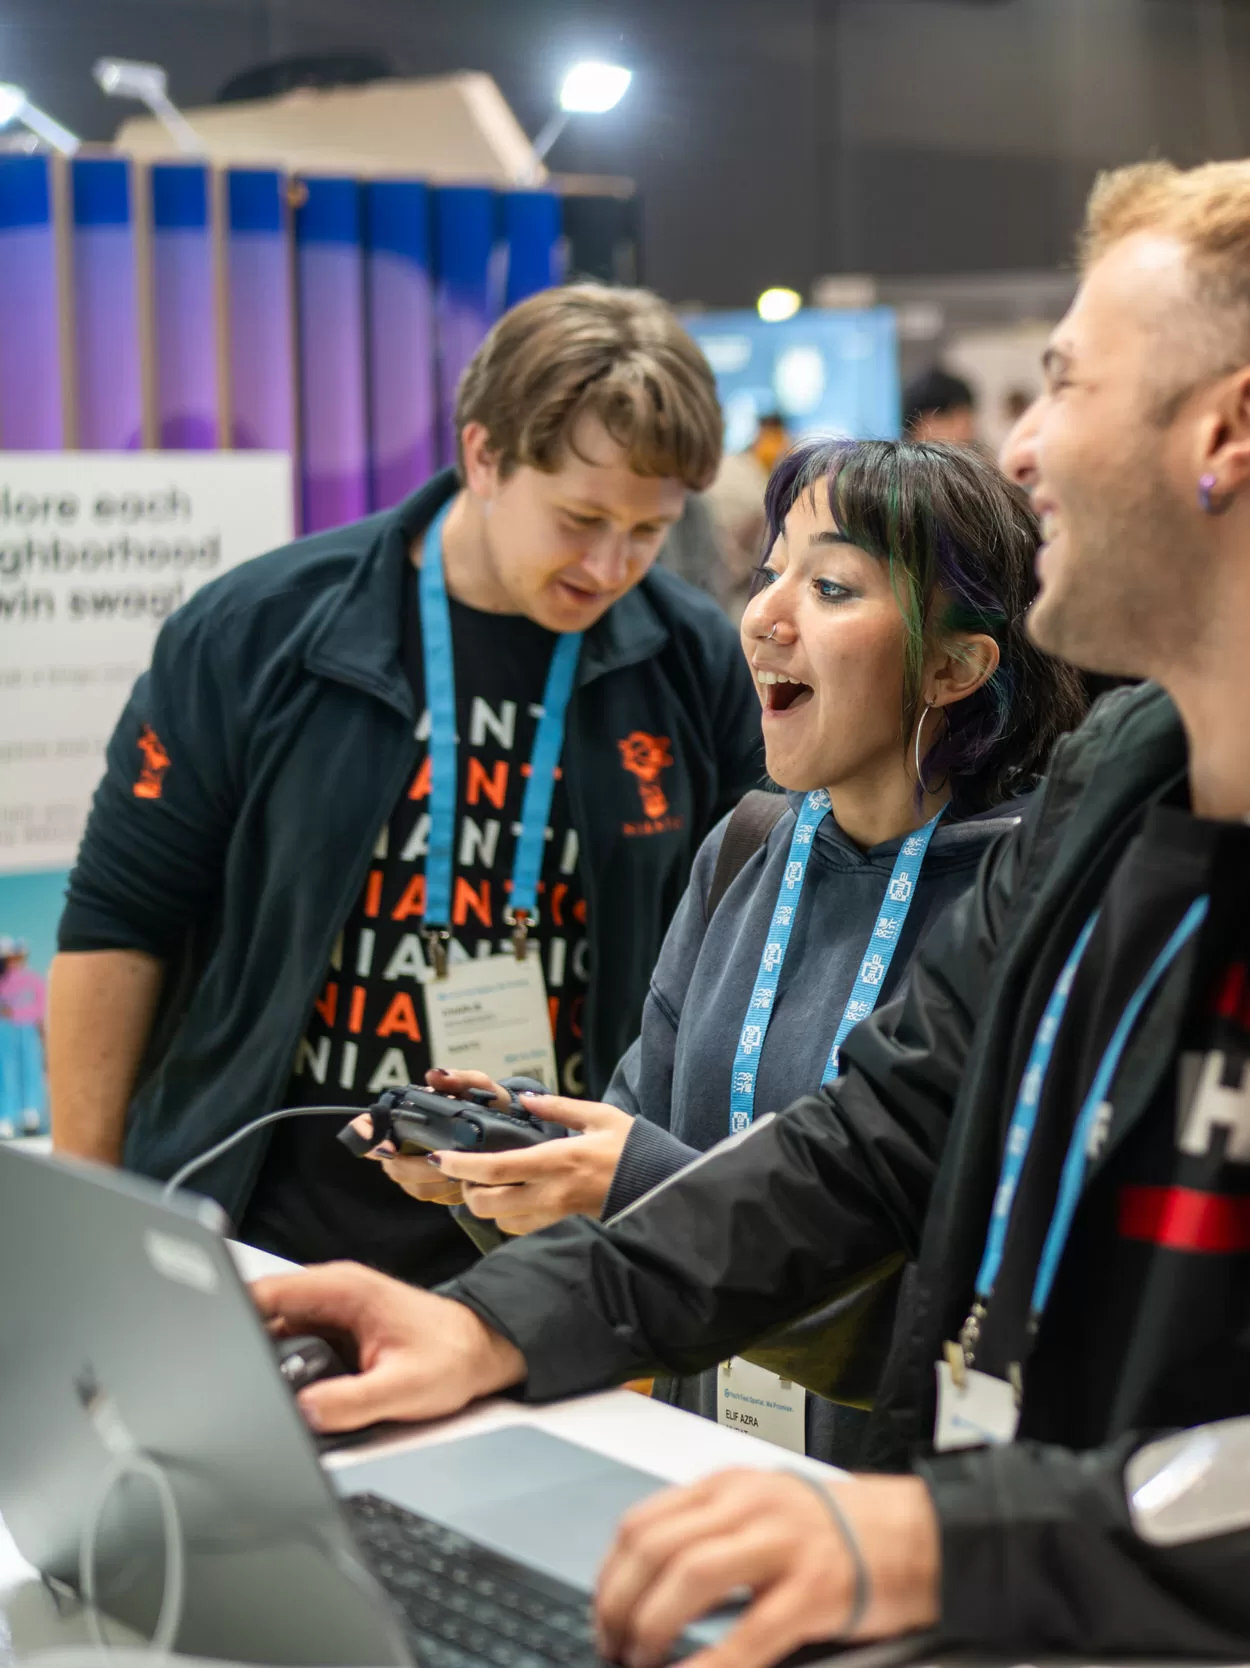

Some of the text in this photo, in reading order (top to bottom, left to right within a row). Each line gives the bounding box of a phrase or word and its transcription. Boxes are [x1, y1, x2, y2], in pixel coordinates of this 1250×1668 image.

[93, 483, 192, 524] each
[725, 1409, 759, 1428] ELIF AZRA
